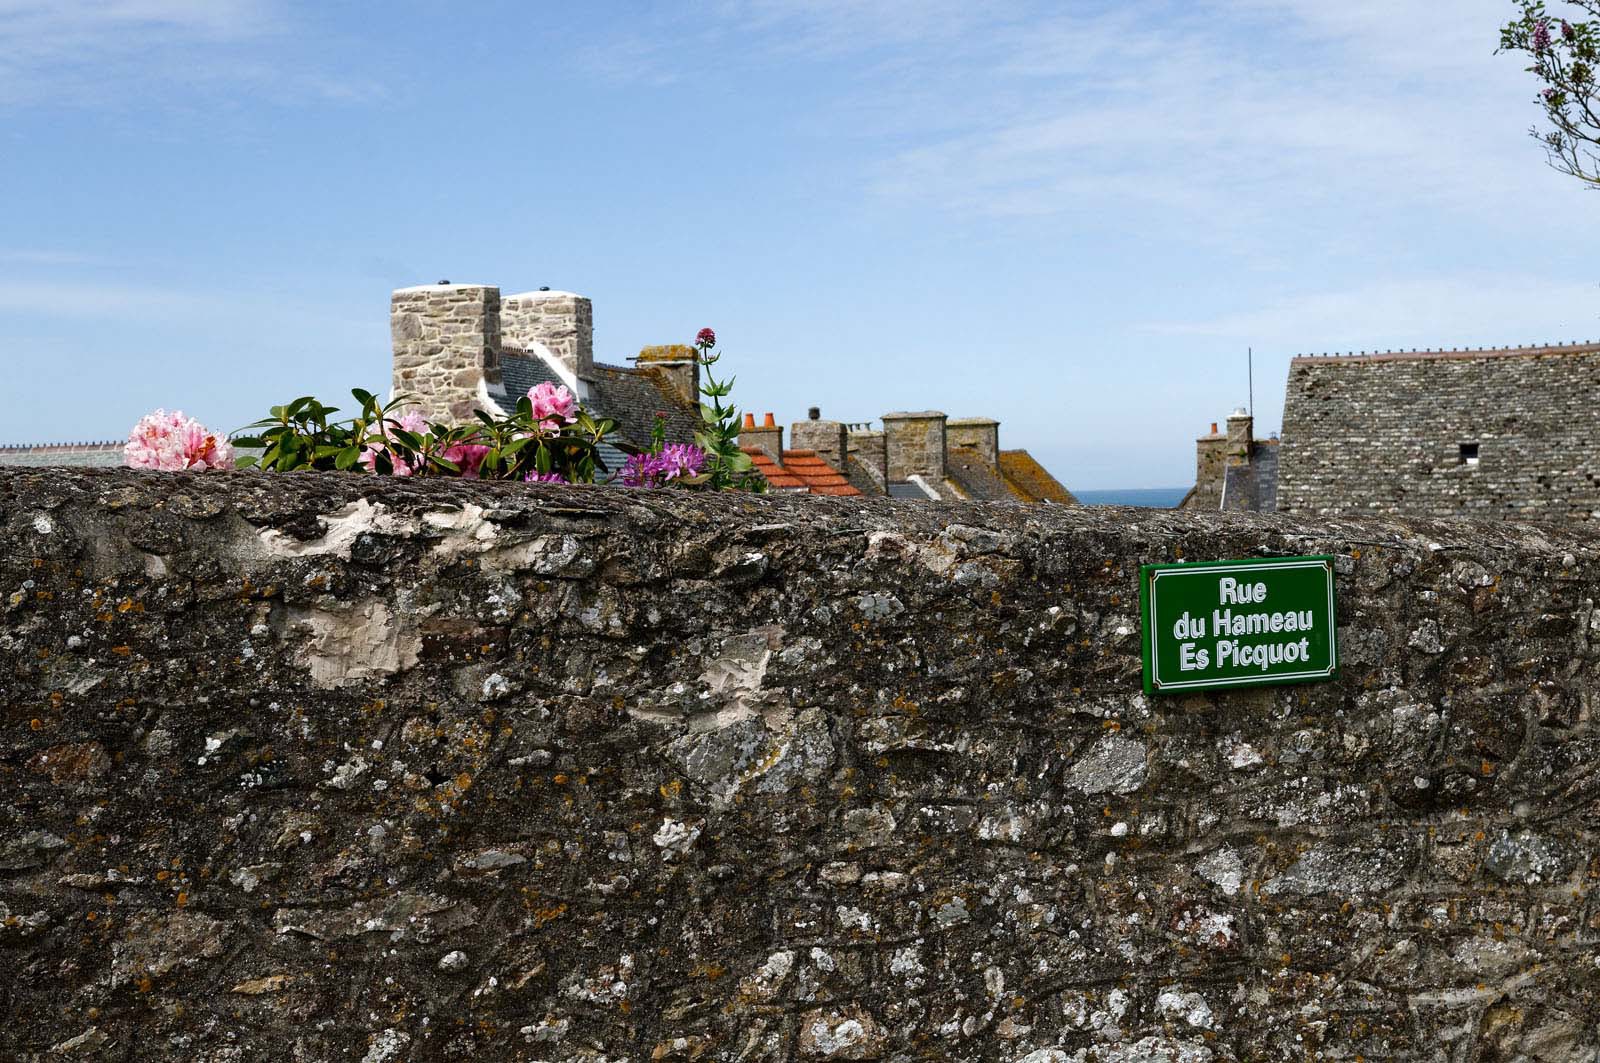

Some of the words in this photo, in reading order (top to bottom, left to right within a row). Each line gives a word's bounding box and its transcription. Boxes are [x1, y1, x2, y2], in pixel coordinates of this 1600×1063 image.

[1219, 577, 1267, 605] Rue
[1173, 612, 1206, 640] du
[1212, 608, 1313, 637] Hameau
[1179, 643, 1210, 672] Es
[1216, 636, 1310, 671] Picquot
